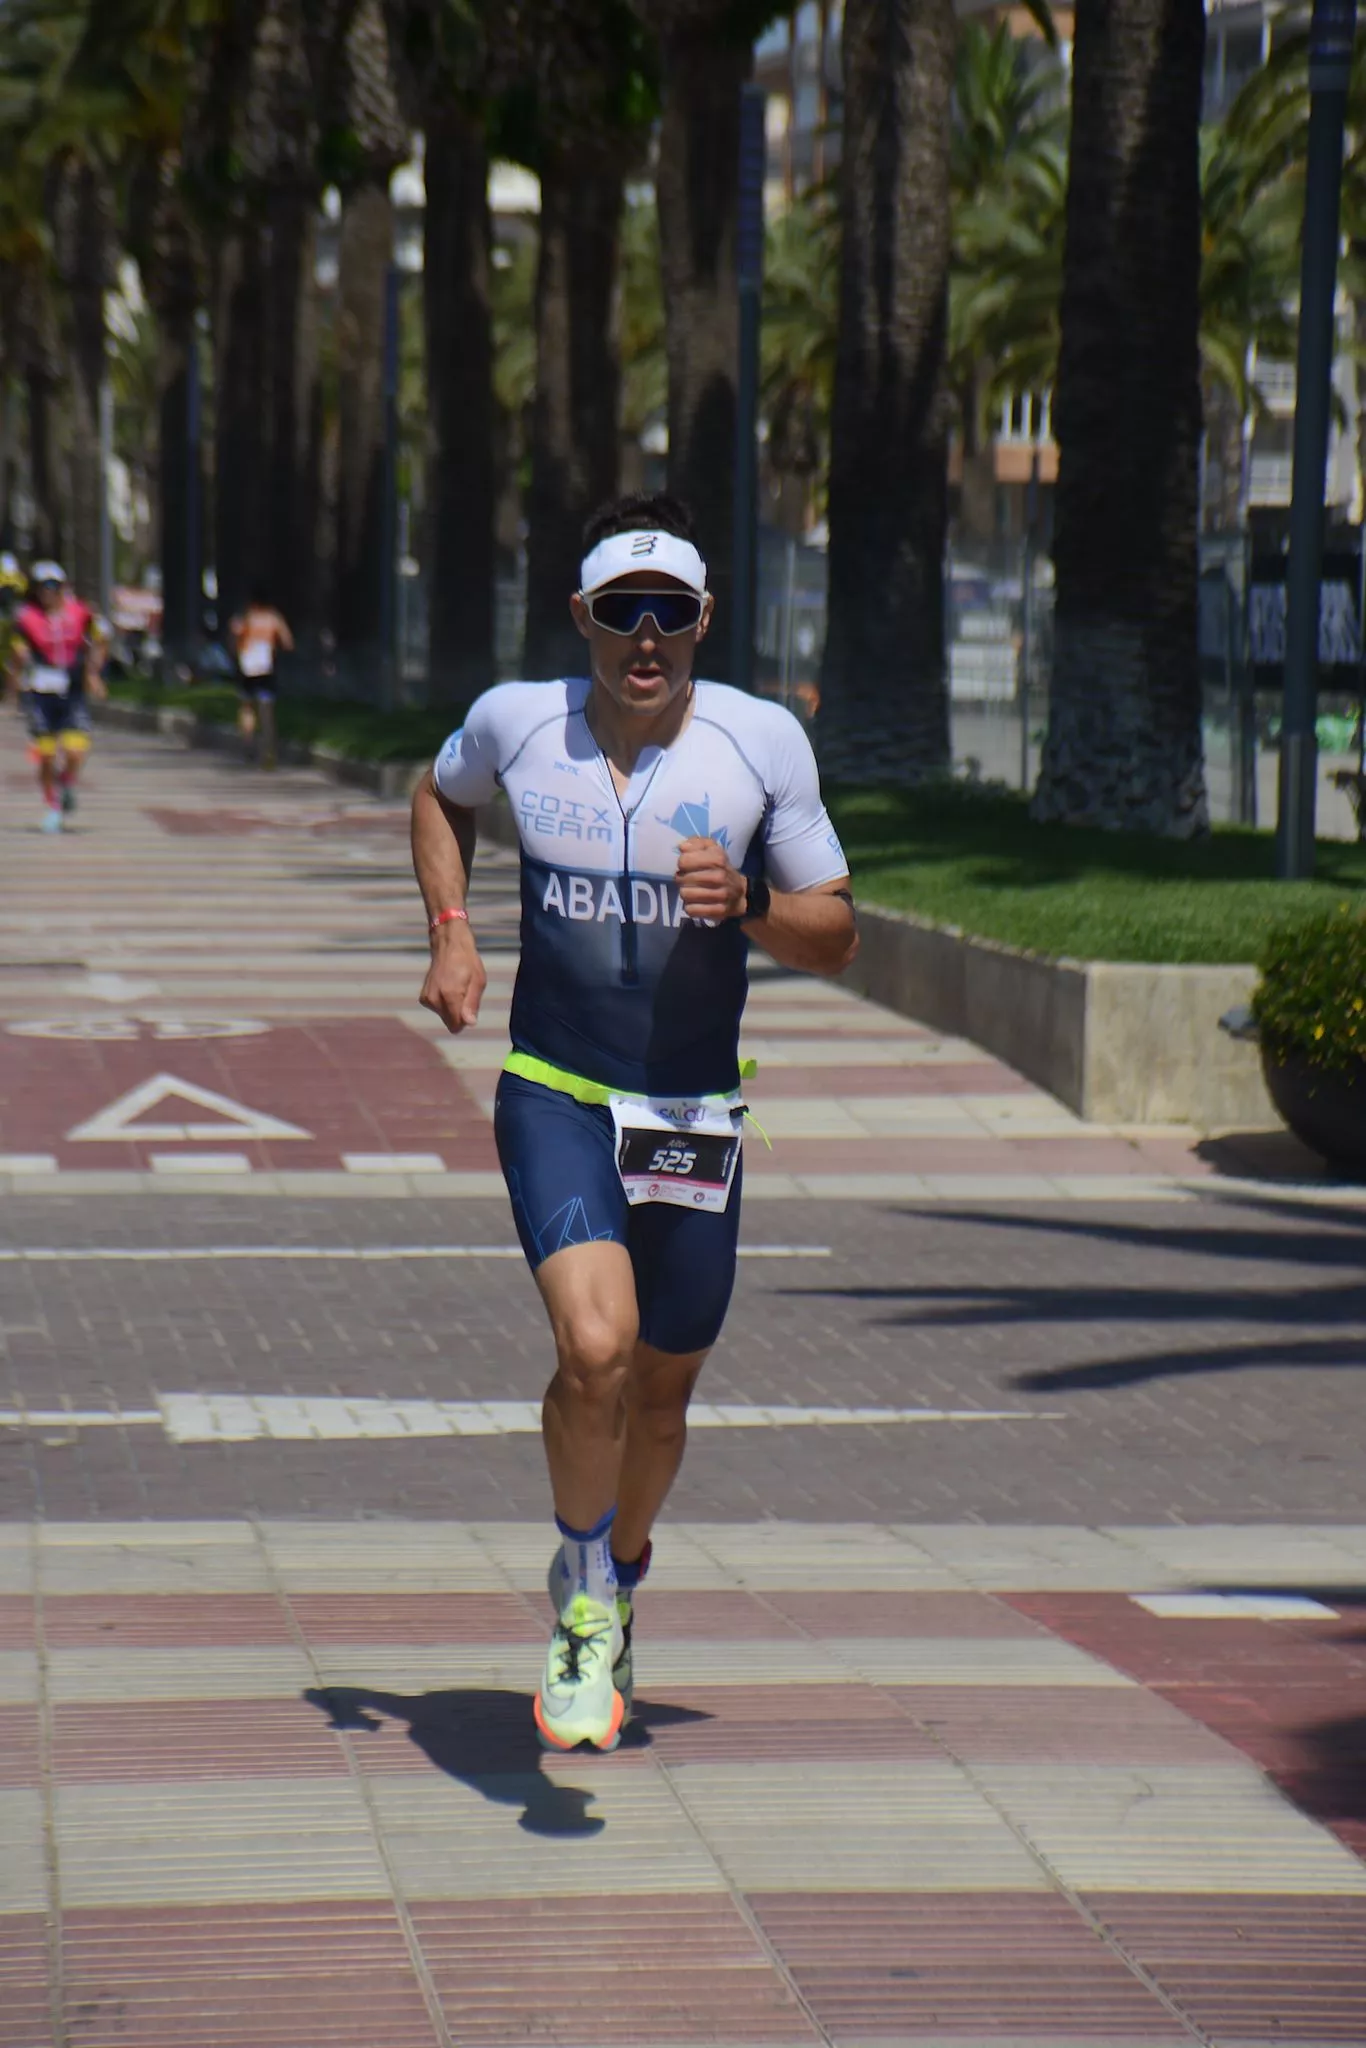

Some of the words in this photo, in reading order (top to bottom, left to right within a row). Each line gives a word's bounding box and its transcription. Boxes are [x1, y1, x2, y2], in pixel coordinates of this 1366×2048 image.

[521, 791, 612, 825] COIX
[519, 810, 612, 843] TEAM
[542, 872, 716, 929] ABADIA
[648, 1149, 697, 1175] 525
